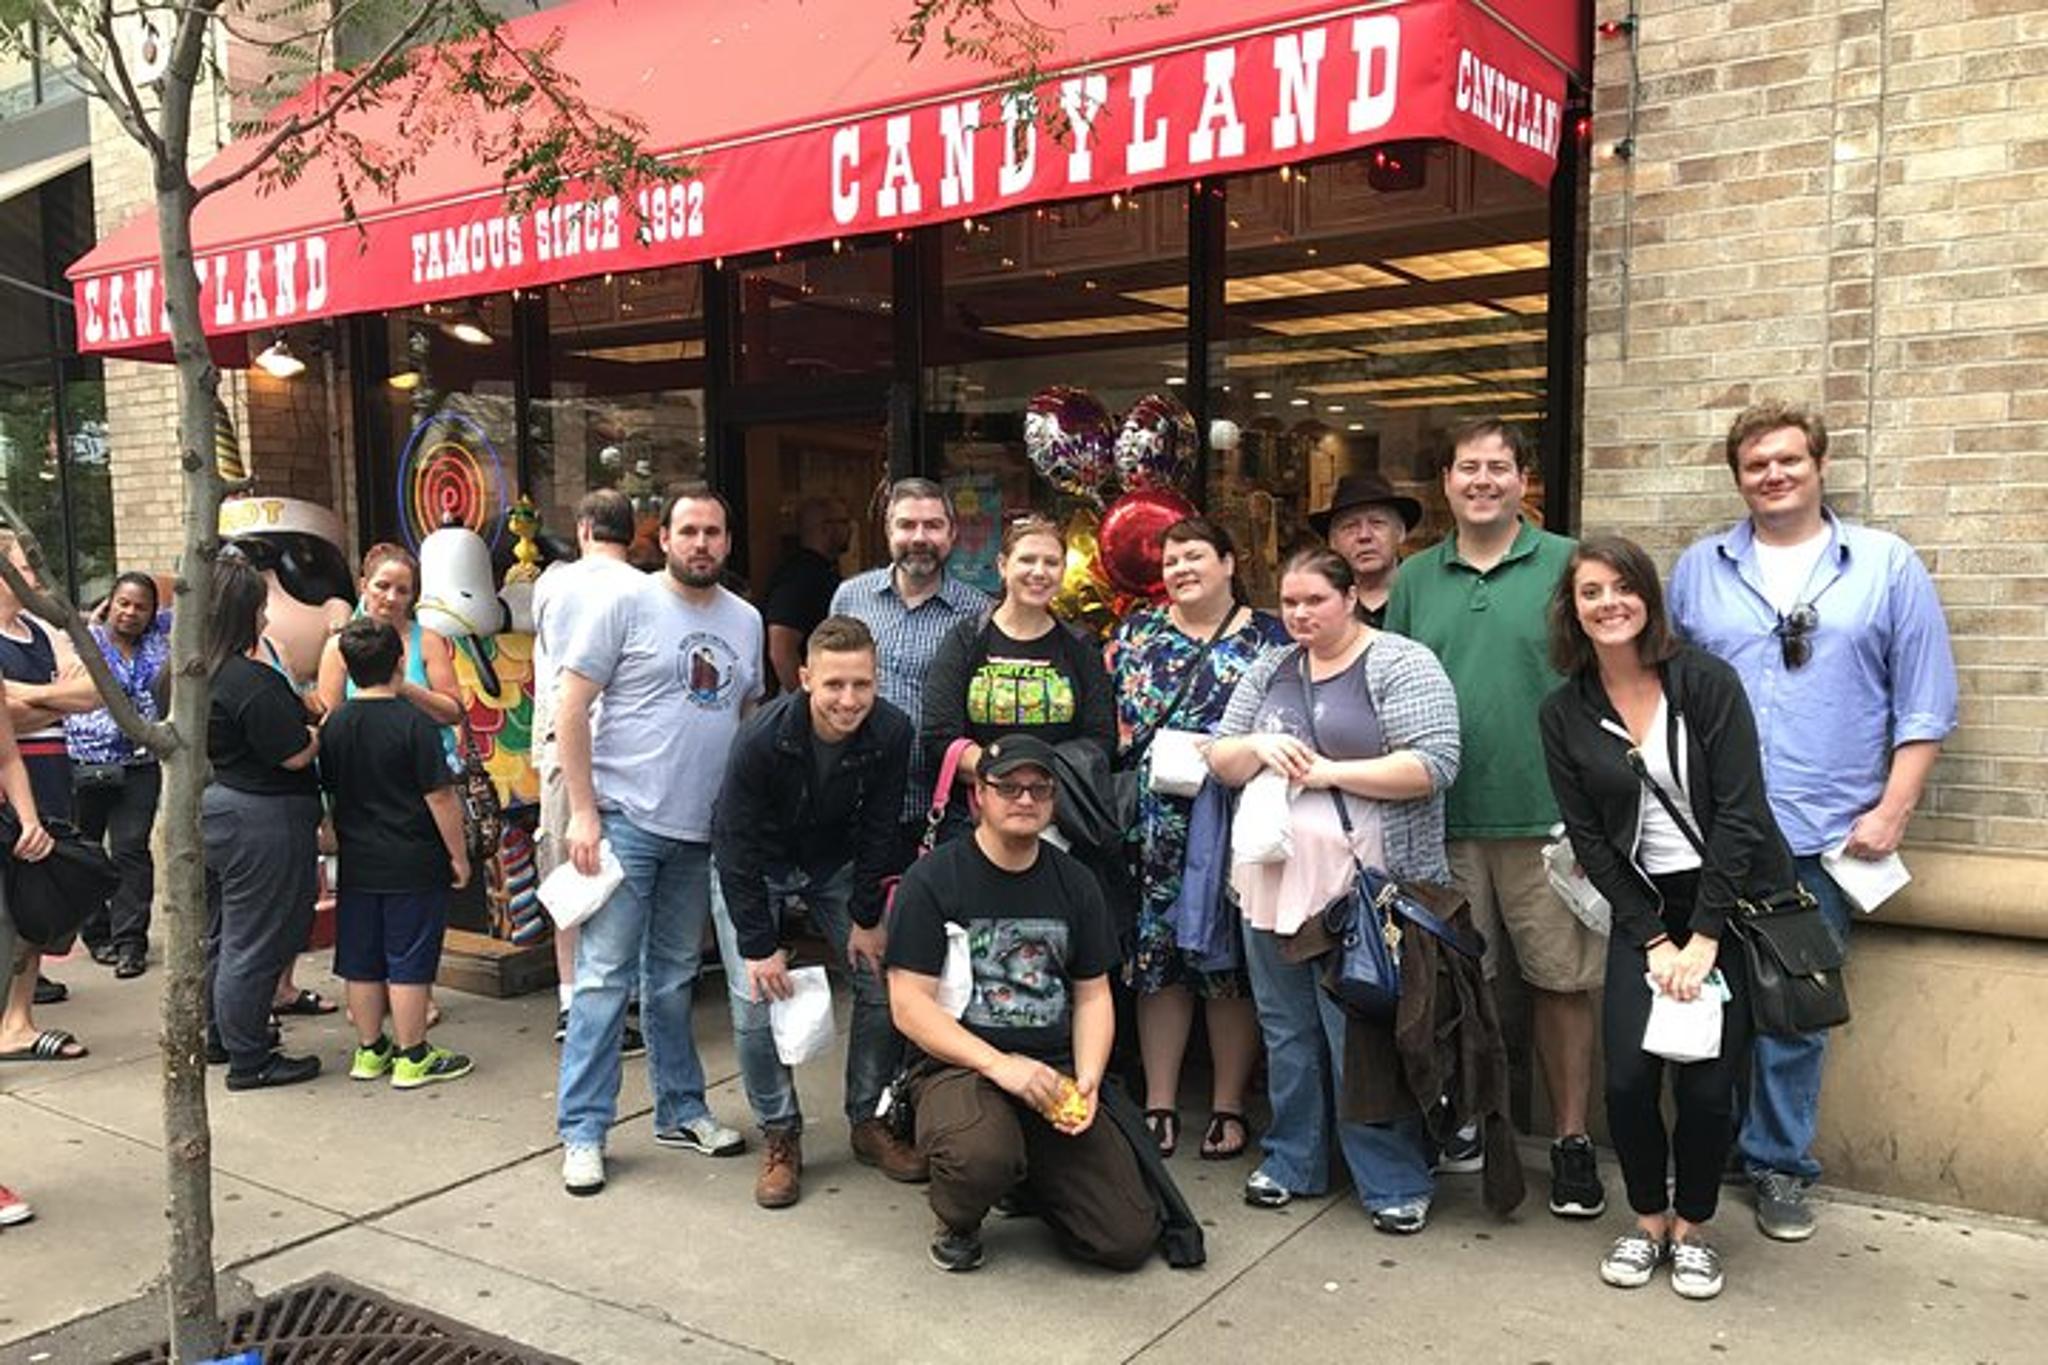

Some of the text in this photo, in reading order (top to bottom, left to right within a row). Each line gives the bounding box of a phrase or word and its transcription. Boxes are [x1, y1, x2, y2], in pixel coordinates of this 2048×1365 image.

[831, 14, 1400, 224] CANDYLAND
[411, 181, 704, 284] FAMOUS SINCE 1932
[84, 236, 327, 343] CANLAND
